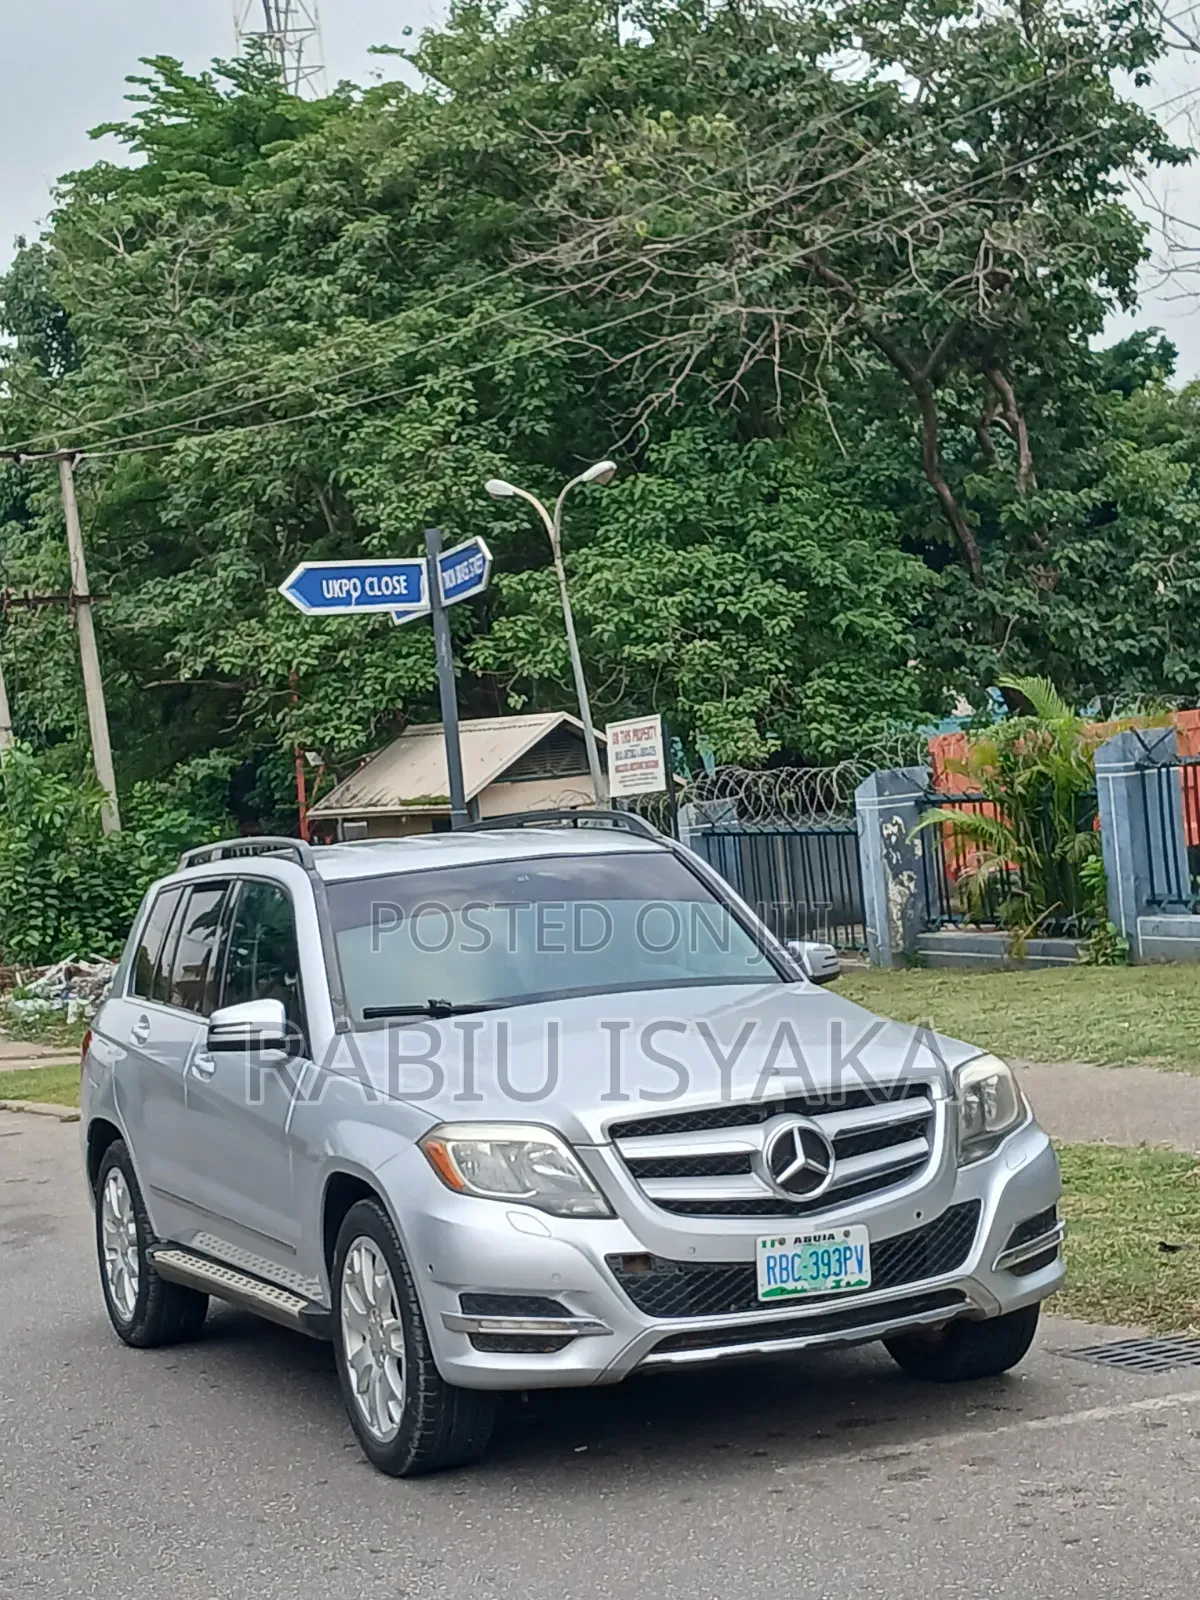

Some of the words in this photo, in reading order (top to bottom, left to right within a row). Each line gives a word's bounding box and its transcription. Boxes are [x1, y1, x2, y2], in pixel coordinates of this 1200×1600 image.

[322, 577, 361, 599] UKPO
[365, 575, 408, 596] CLOSE
[766, 1244, 864, 1286] RBC-393PV
